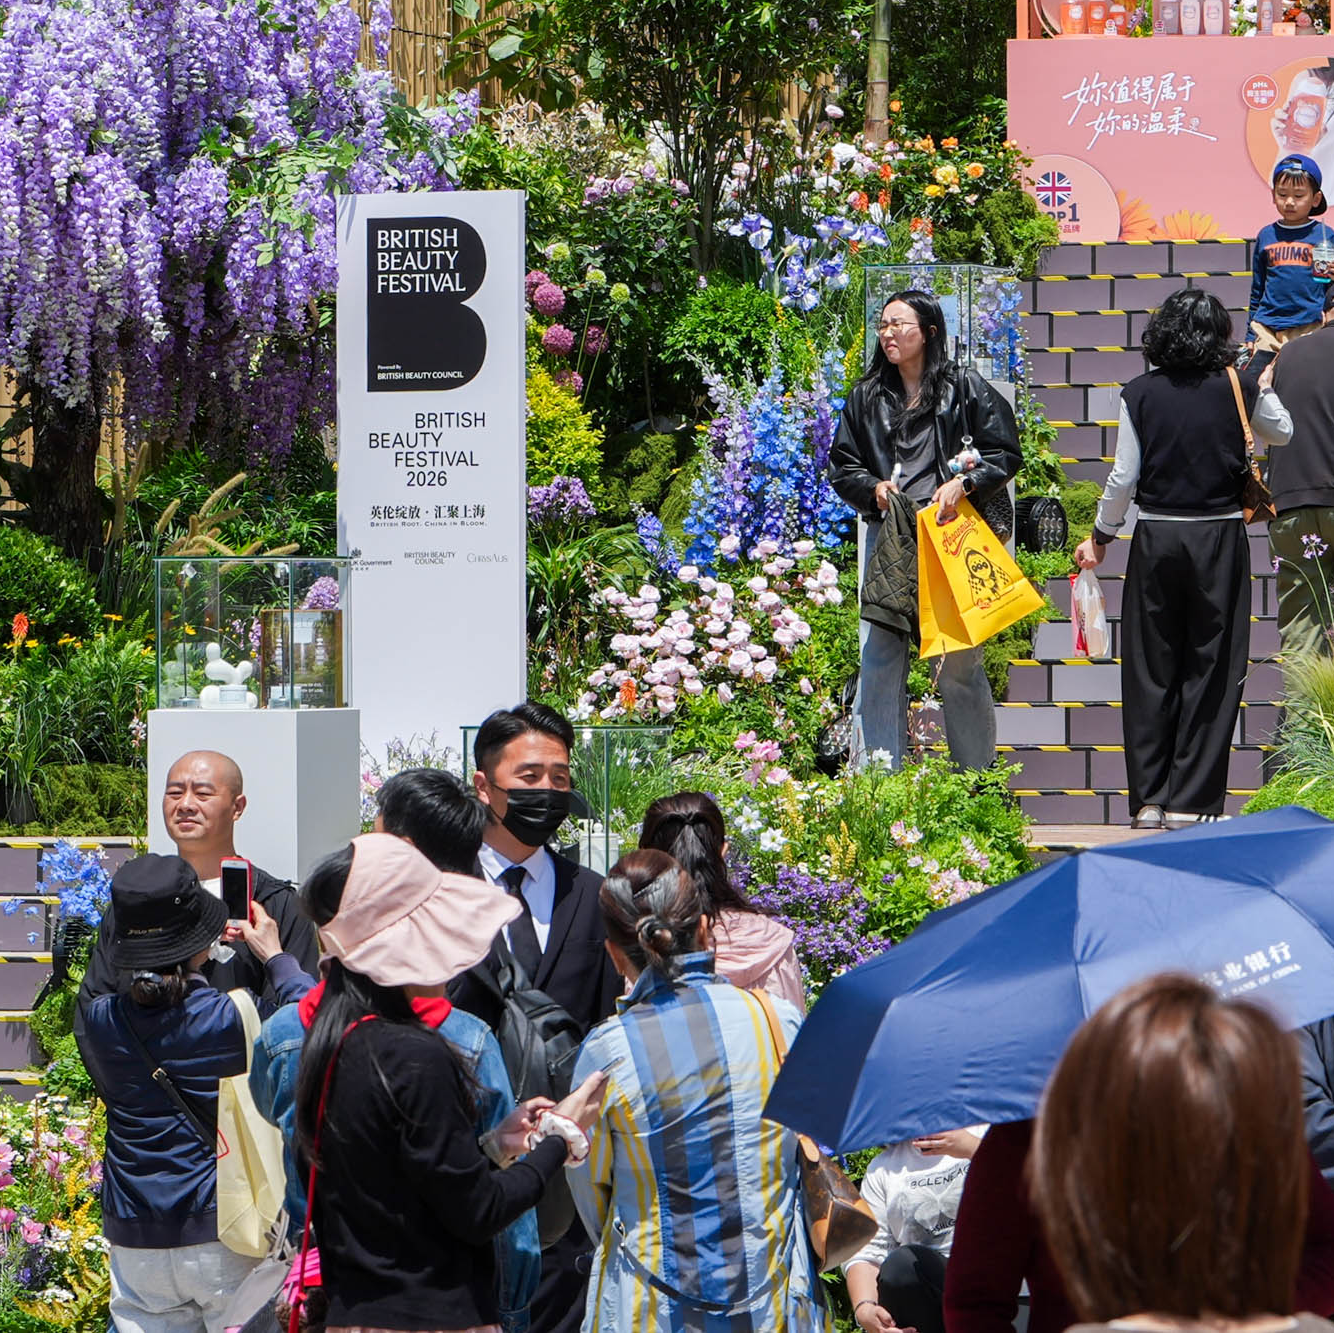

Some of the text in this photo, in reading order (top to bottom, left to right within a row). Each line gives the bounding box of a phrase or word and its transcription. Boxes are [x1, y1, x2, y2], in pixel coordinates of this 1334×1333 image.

[377, 228, 458, 249] BRITISH
[377, 250, 459, 271] BEAUTY
[1269, 246, 1310, 263] CHUMS
[377, 272, 467, 294] FESTIVAL
[377, 372, 405, 380] BRITISH
[432, 371, 465, 379] COUNCIL
[415, 412, 486, 428] BRITISH
[369, 432, 443, 449] BEAUTY
[394, 450, 479, 467] FESTIVAL
[407, 470, 448, 487] 2026
[430, 551, 456, 559] BEAUTY
